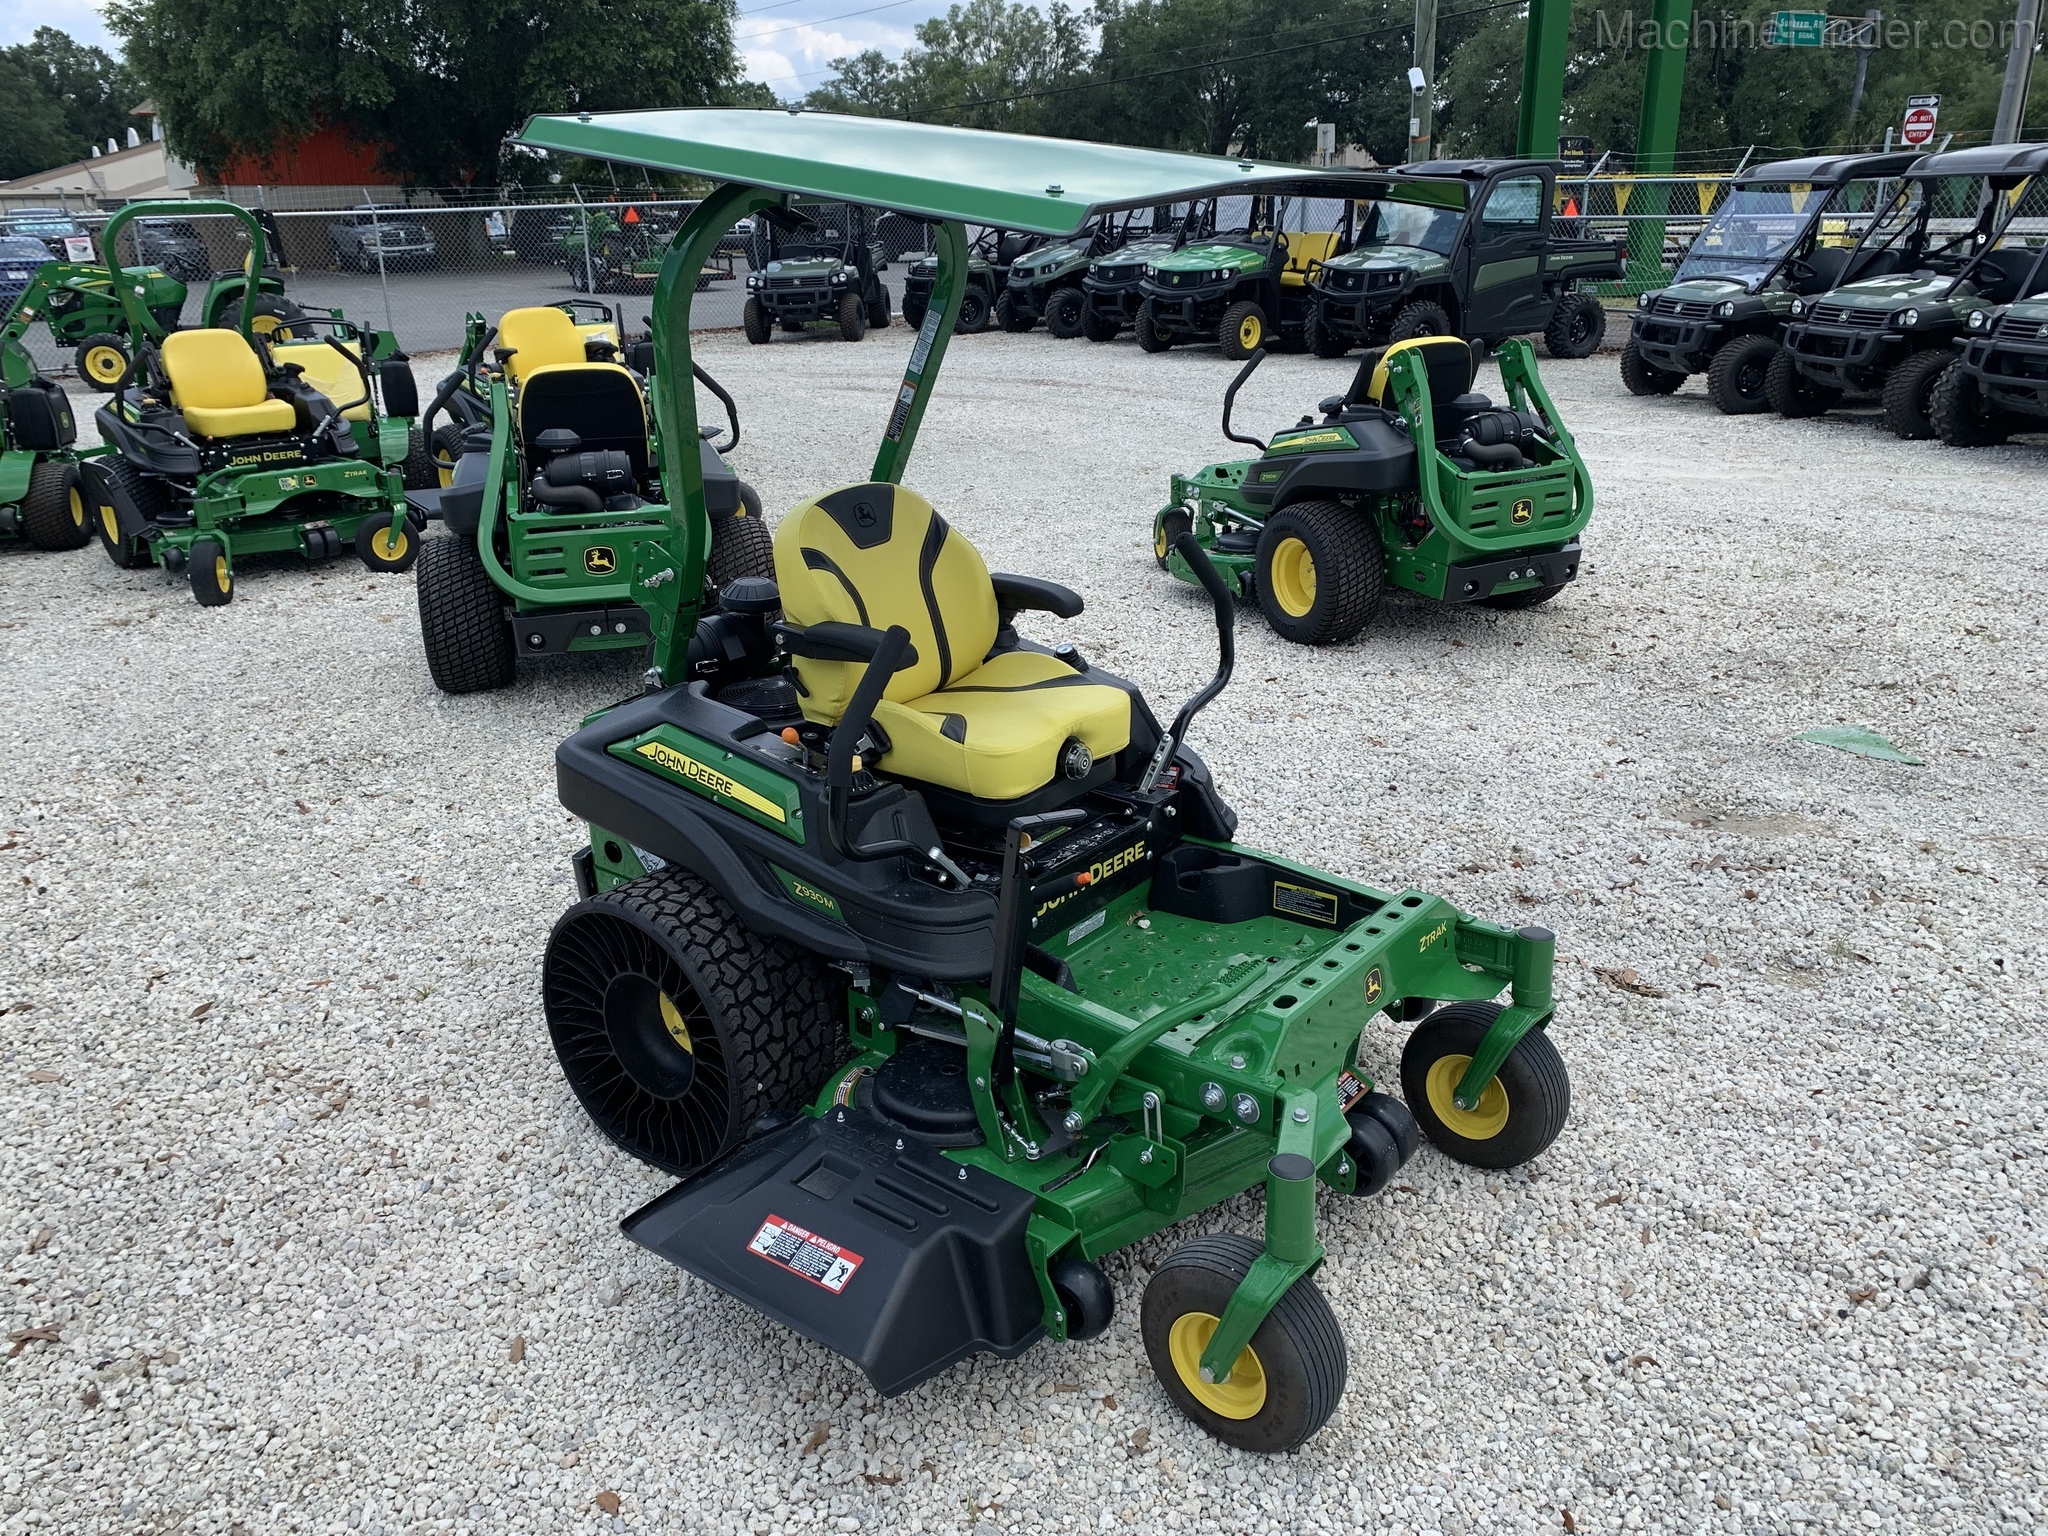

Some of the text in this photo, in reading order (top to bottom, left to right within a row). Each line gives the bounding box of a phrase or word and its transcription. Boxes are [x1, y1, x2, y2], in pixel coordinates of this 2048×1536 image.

[1798, 32, 1816, 40] SIGNAL
[1303, 434, 1337, 445] JOHN DEERE
[229, 450, 302, 466] JOHN DEERE
[344, 469, 368, 478] ZTRAK
[649, 745, 734, 795] JOHN DEERE
[1089, 840, 1145, 886] DEERE
[792, 881, 835, 910] Z930M
[1419, 920, 1447, 954] ZTRAK
[786, 1223, 841, 1254] DANGER PELIGRO
